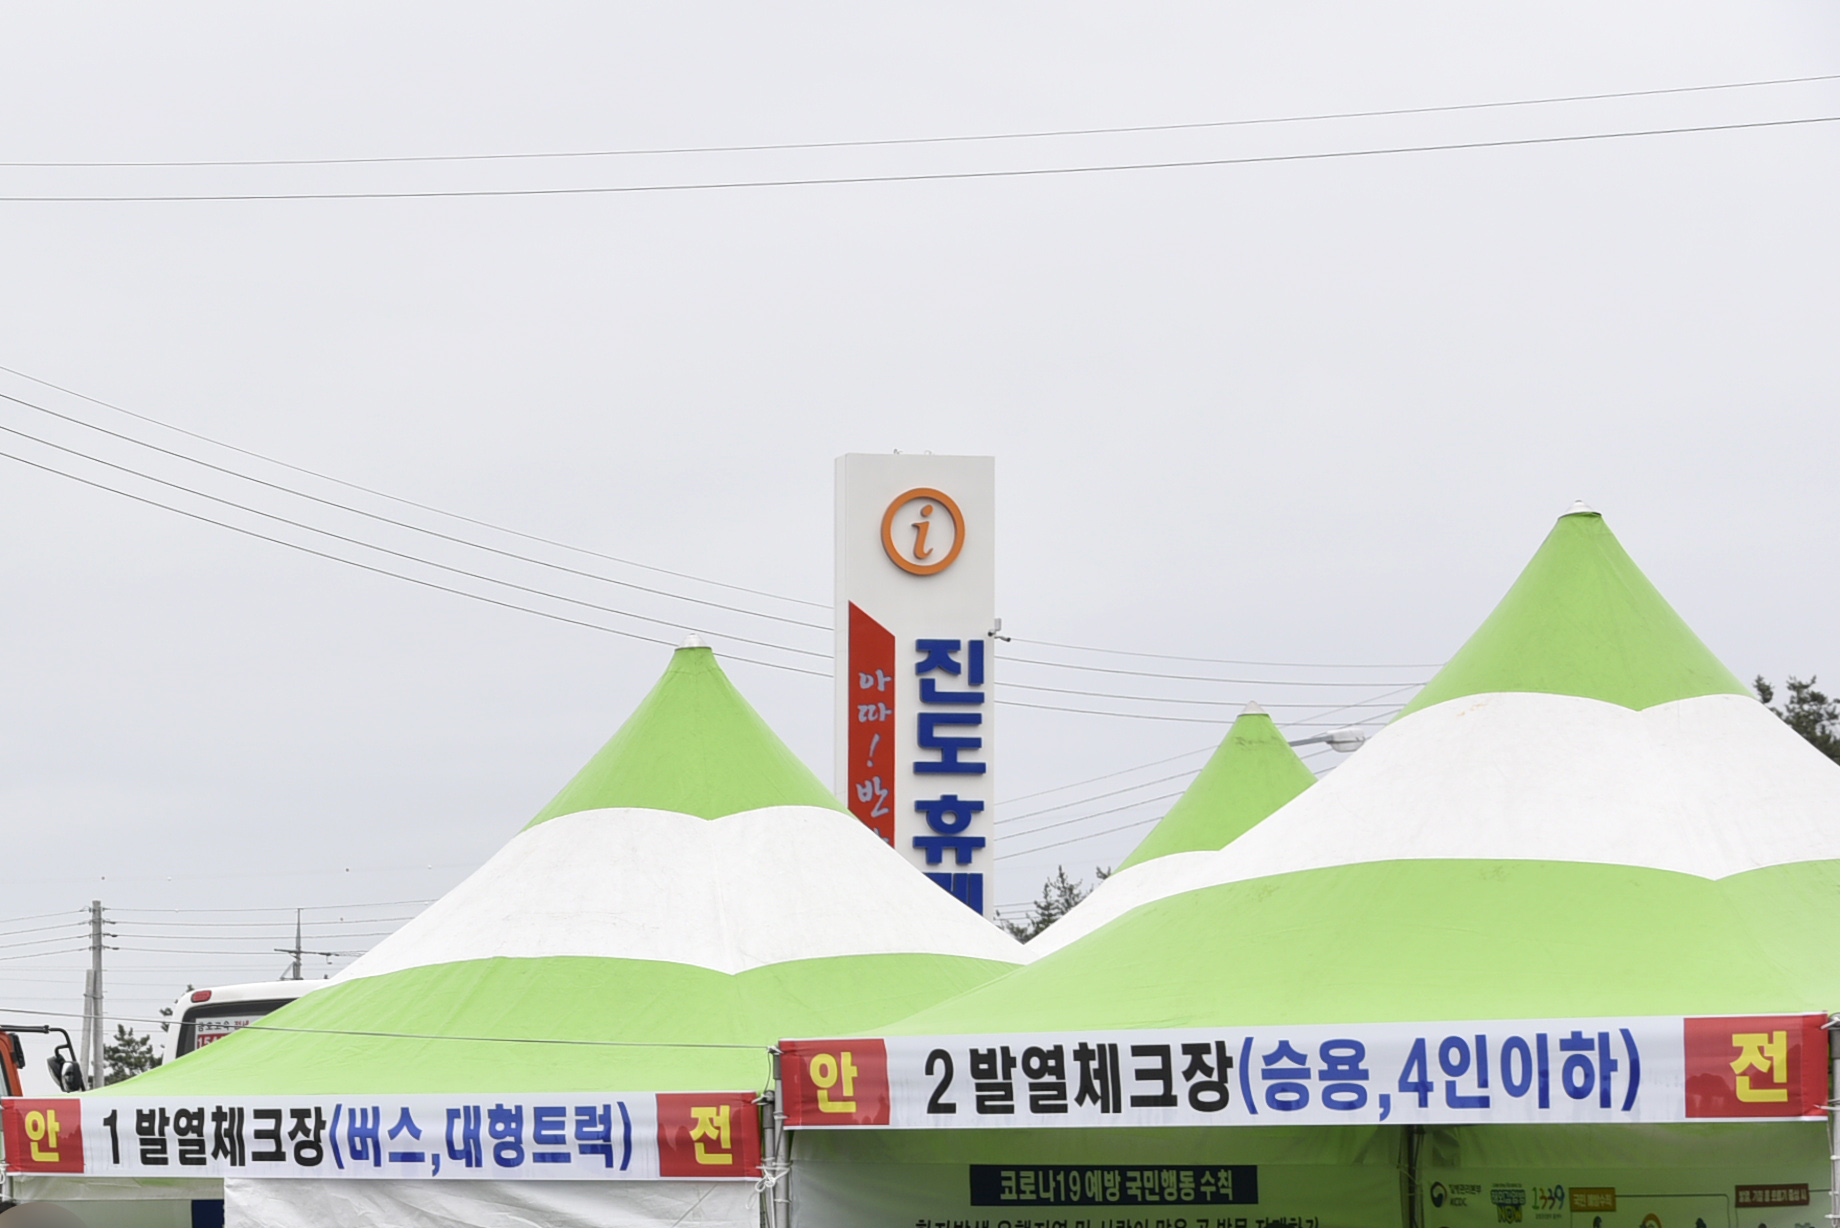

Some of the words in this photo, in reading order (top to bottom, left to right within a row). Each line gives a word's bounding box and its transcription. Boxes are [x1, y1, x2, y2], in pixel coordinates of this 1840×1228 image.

[856, 776, 890, 844] 반
[809, 1051, 858, 1113] 안
[925, 1049, 957, 1114] 2
[969, 1029, 1641, 1121] 발열체크장(승용,4인이하)
[1729, 1030, 1789, 1103] 전
[25, 1109, 60, 1162] 안
[103, 1109, 120, 1164] 1
[135, 1101, 632, 1176] 발열체크장(버스,대형트럭)
[689, 1104, 733, 1165] 전
[1000, 1170, 1082, 1201] 코로나19
[1084, 1170, 1121, 1201] 예방
[1126, 1169, 1196, 1201] 국민행동
[1200, 1169, 1233, 1200] 수칙
[1531, 1184, 1565, 1210] 1339
